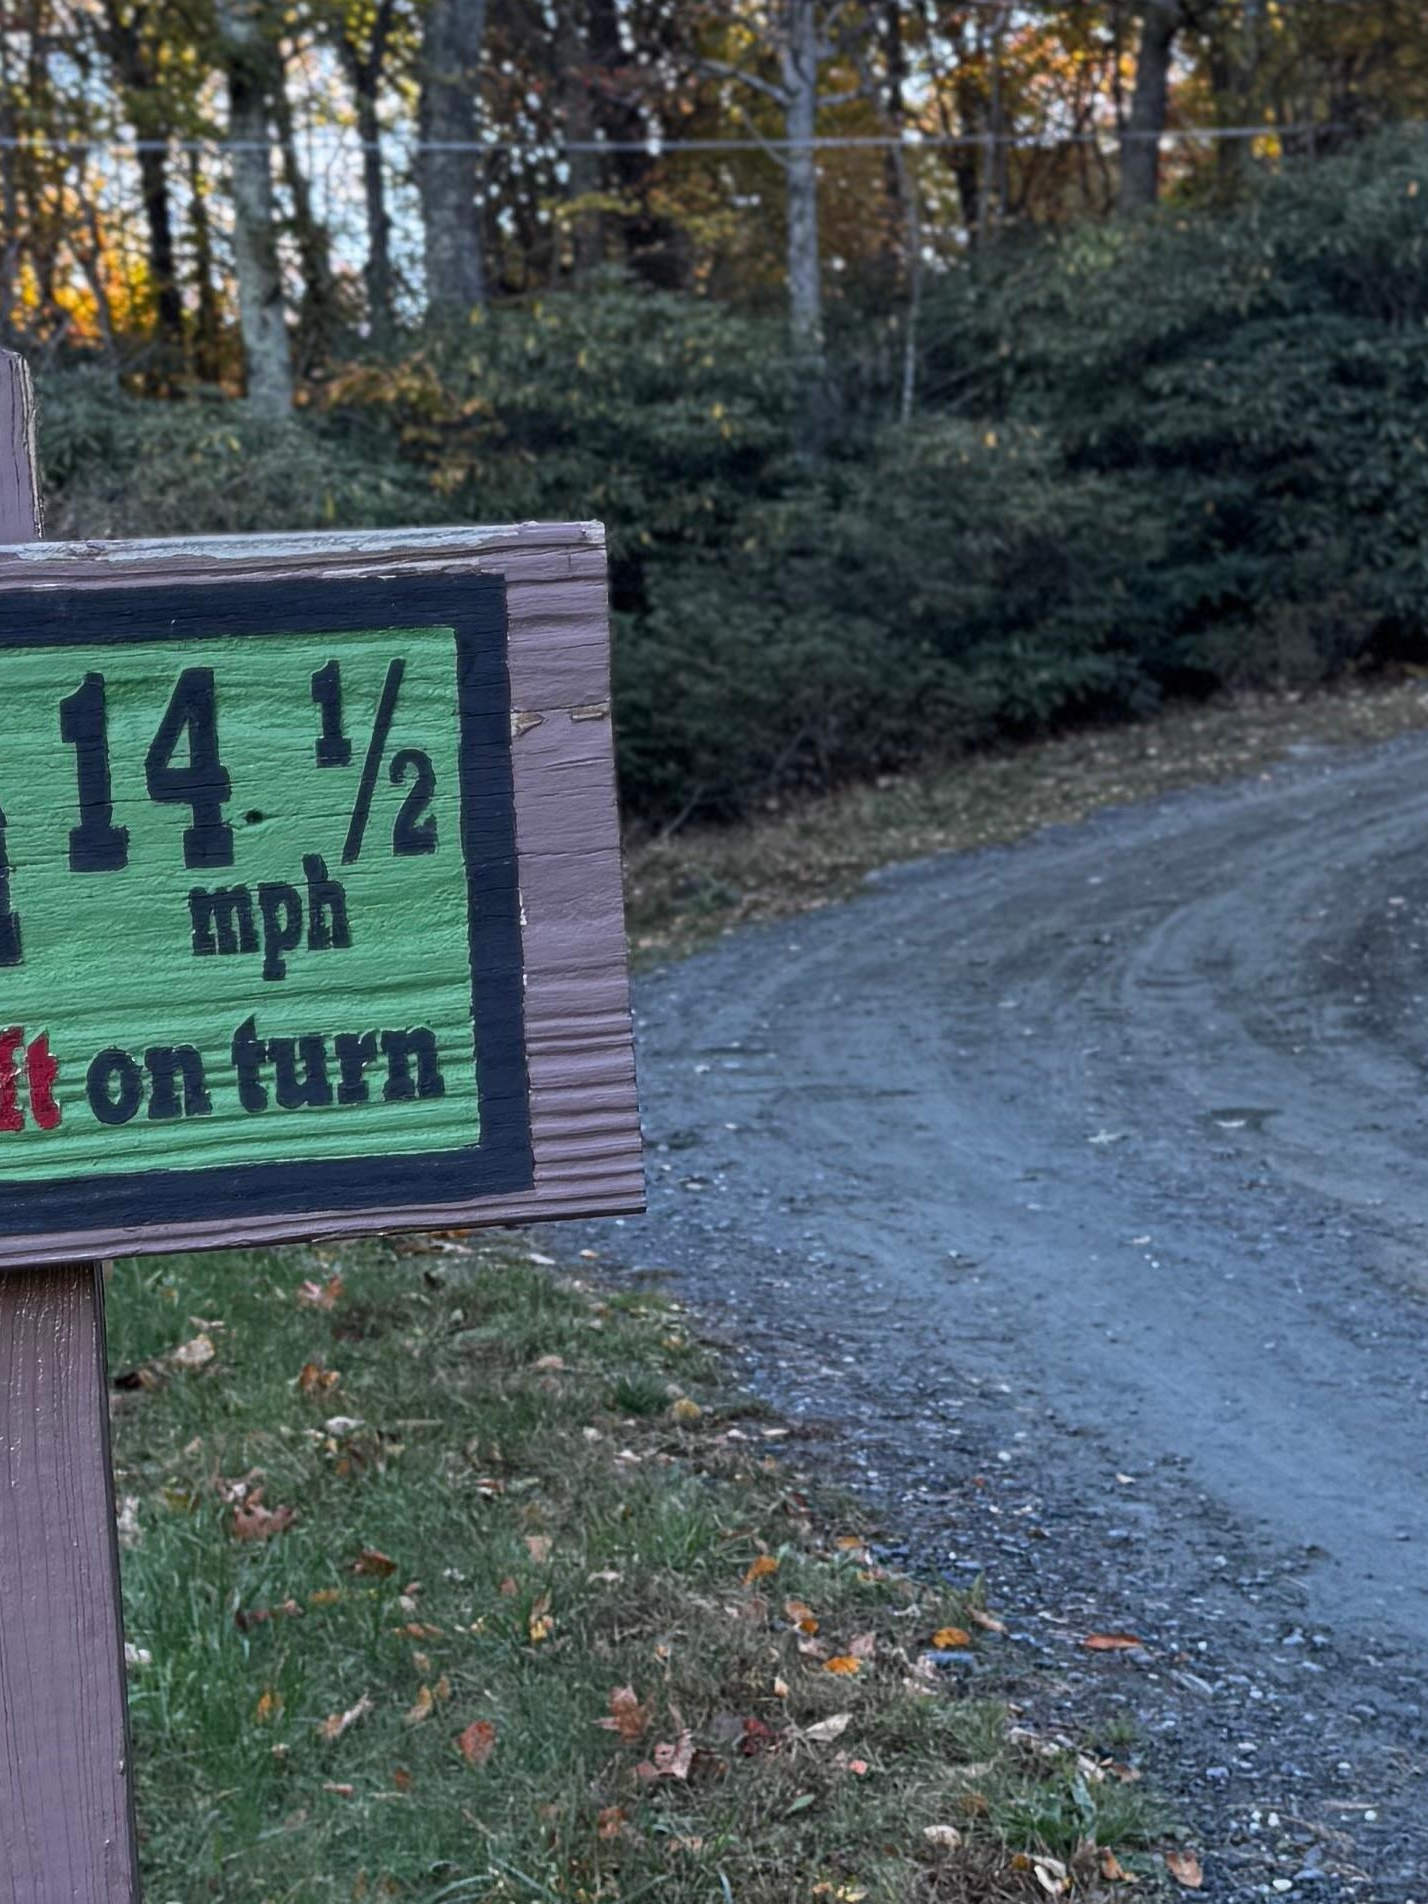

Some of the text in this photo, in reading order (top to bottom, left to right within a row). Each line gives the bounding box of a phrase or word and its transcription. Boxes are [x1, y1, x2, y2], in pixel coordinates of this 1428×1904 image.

[61, 668, 232, 871] 14
[190, 855, 351, 981] mph
[87, 1044, 209, 1124] on
[233, 1015, 442, 1112] turn
